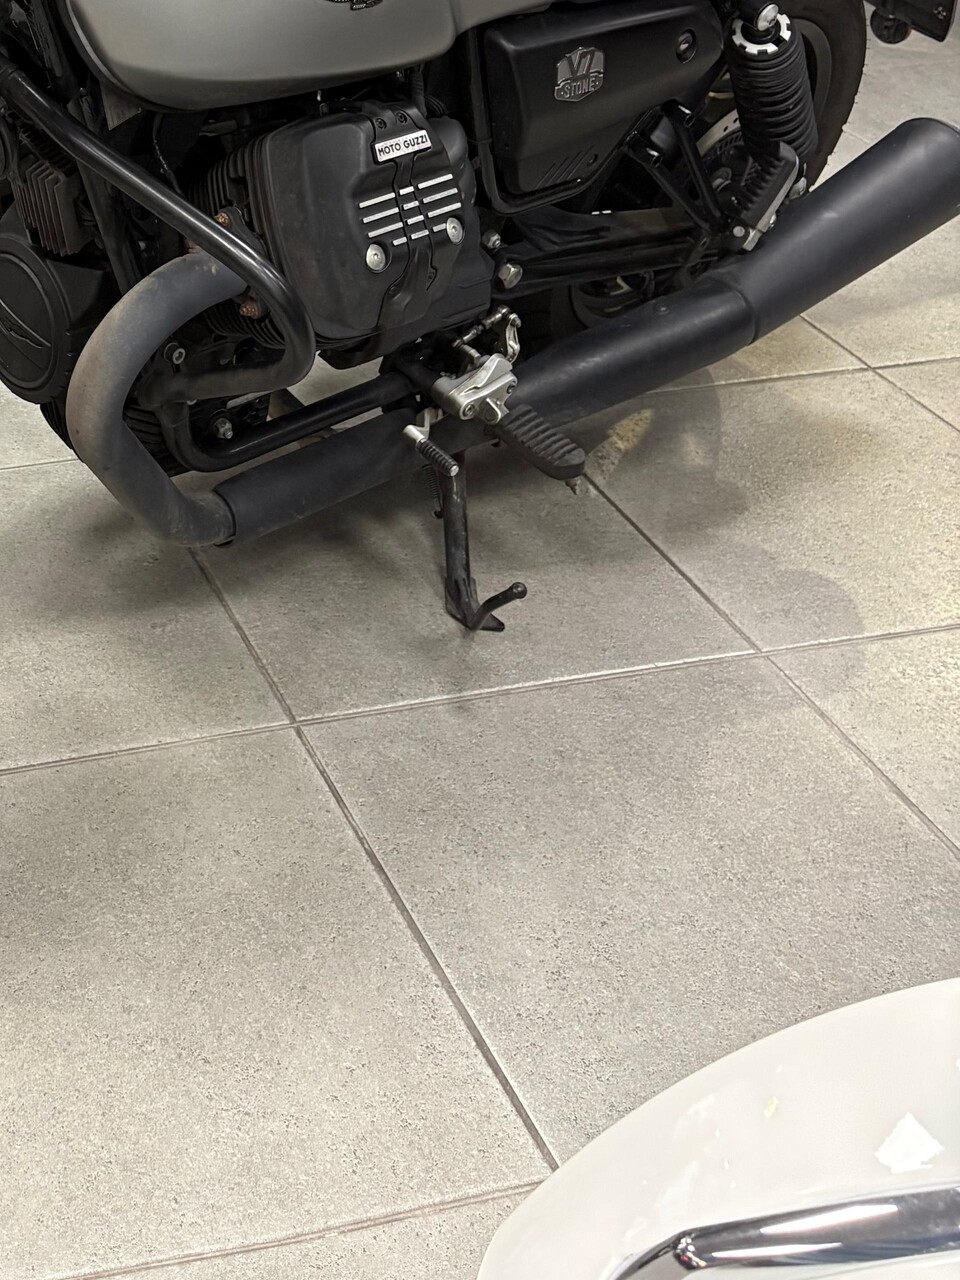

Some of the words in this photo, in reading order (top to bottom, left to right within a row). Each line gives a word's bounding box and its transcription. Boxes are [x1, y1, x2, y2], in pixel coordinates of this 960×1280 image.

[567, 49, 596, 78] V7
[563, 77, 596, 99] STONE
[377, 142, 401, 157] MOTO
[403, 134, 428, 149] GUZZI
